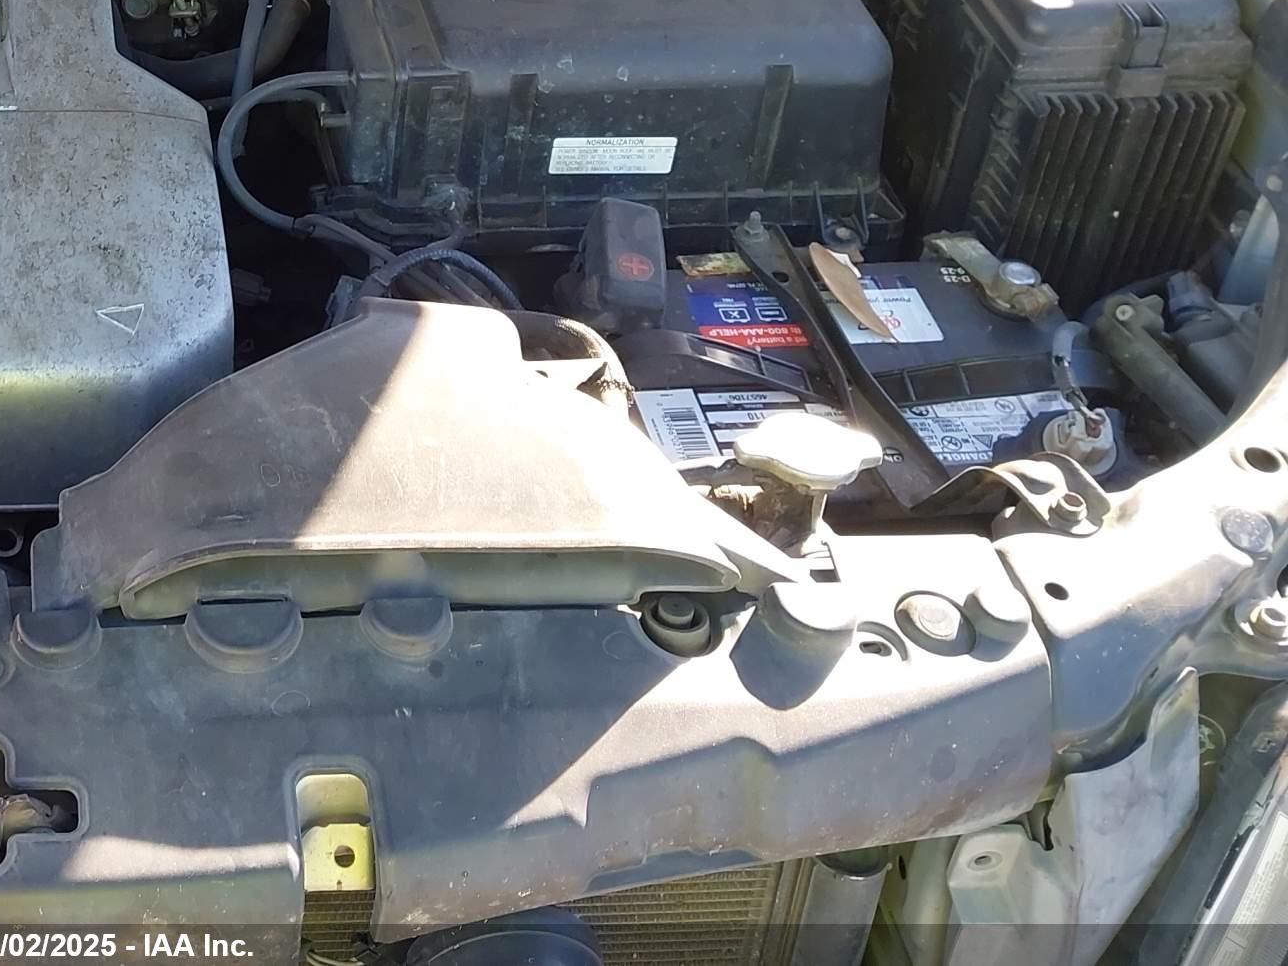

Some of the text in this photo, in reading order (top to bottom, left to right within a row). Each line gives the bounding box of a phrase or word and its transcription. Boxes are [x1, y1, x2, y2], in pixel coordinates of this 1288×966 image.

[585, 138, 644, 146] NORMALIZATION
[943, 275, 972, 283] D-25
[746, 336, 784, 344] battery?
[747, 412, 766, 421] 110
